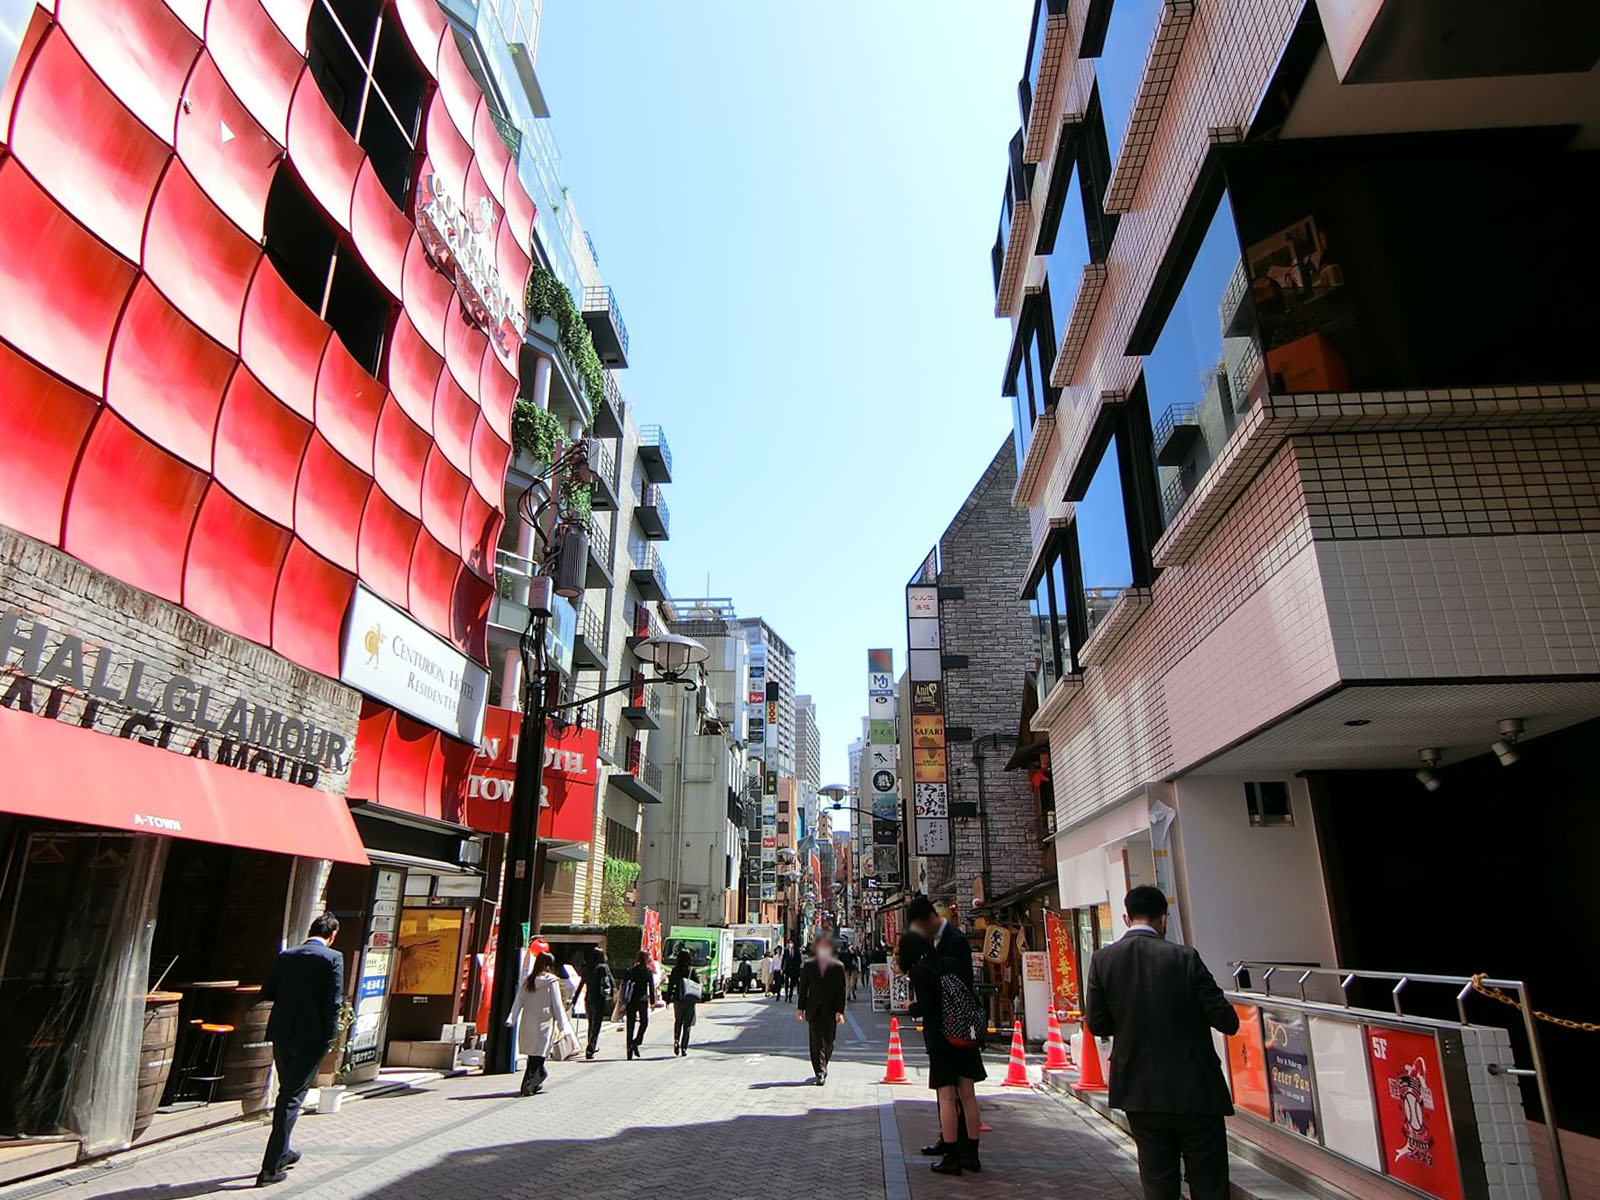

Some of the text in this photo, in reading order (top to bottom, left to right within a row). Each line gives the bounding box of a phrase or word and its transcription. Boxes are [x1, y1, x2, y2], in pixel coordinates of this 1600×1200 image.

[0, 610, 347, 771] HALL GLAMOUR
[407, 671, 458, 713] RESIDENTIA
[914, 728, 943, 736] SAFARI
[468, 774, 550, 808] TOWR
[134, 813, 181, 831] A-TOWN
[1371, 1036, 1388, 1060] 5F
[1272, 1066, 1310, 1092] Peter Pan
